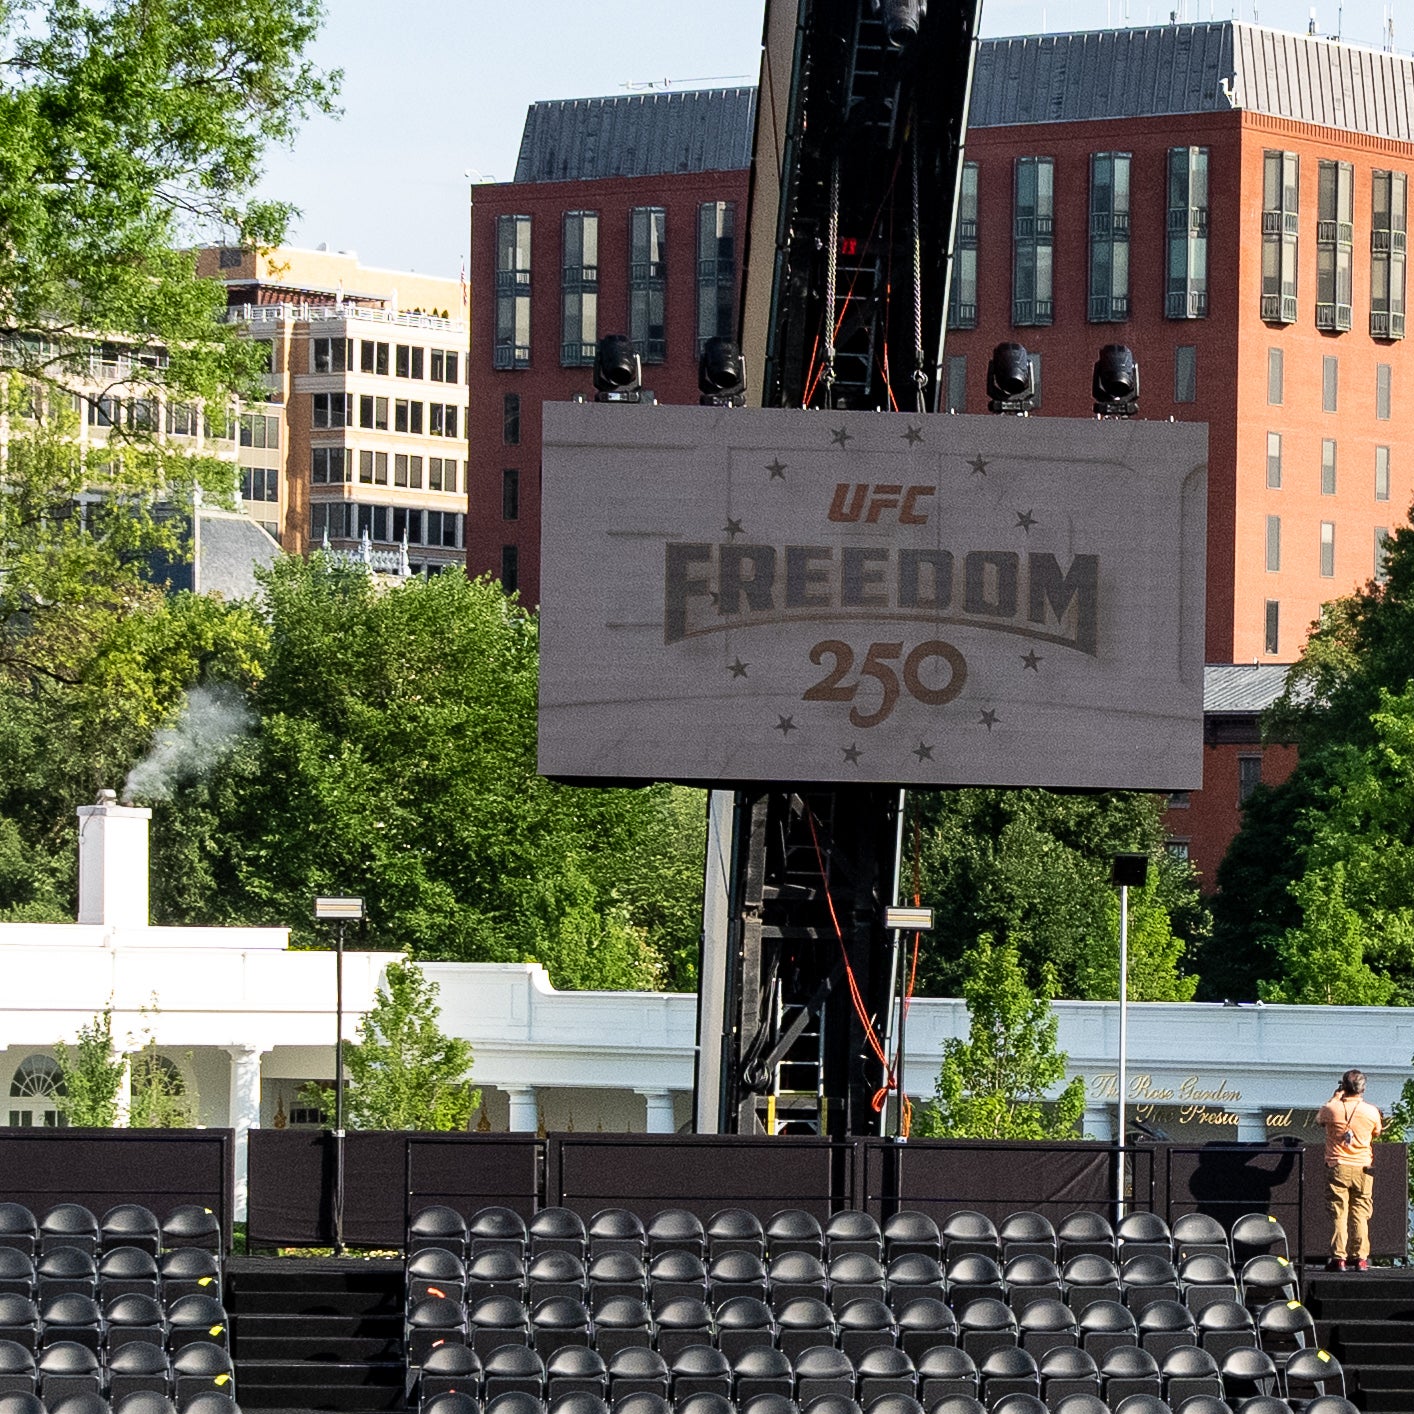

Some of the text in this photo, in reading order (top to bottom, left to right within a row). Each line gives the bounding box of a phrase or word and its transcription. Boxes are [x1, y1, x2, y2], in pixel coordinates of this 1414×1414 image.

[828, 482, 936, 525] UFC
[665, 541, 1099, 657] FREEDOM
[802, 639, 969, 729] 250
[1090, 1073, 1243, 1101] Th Rose Garden
[1179, 1104, 1292, 1127] Presiial
